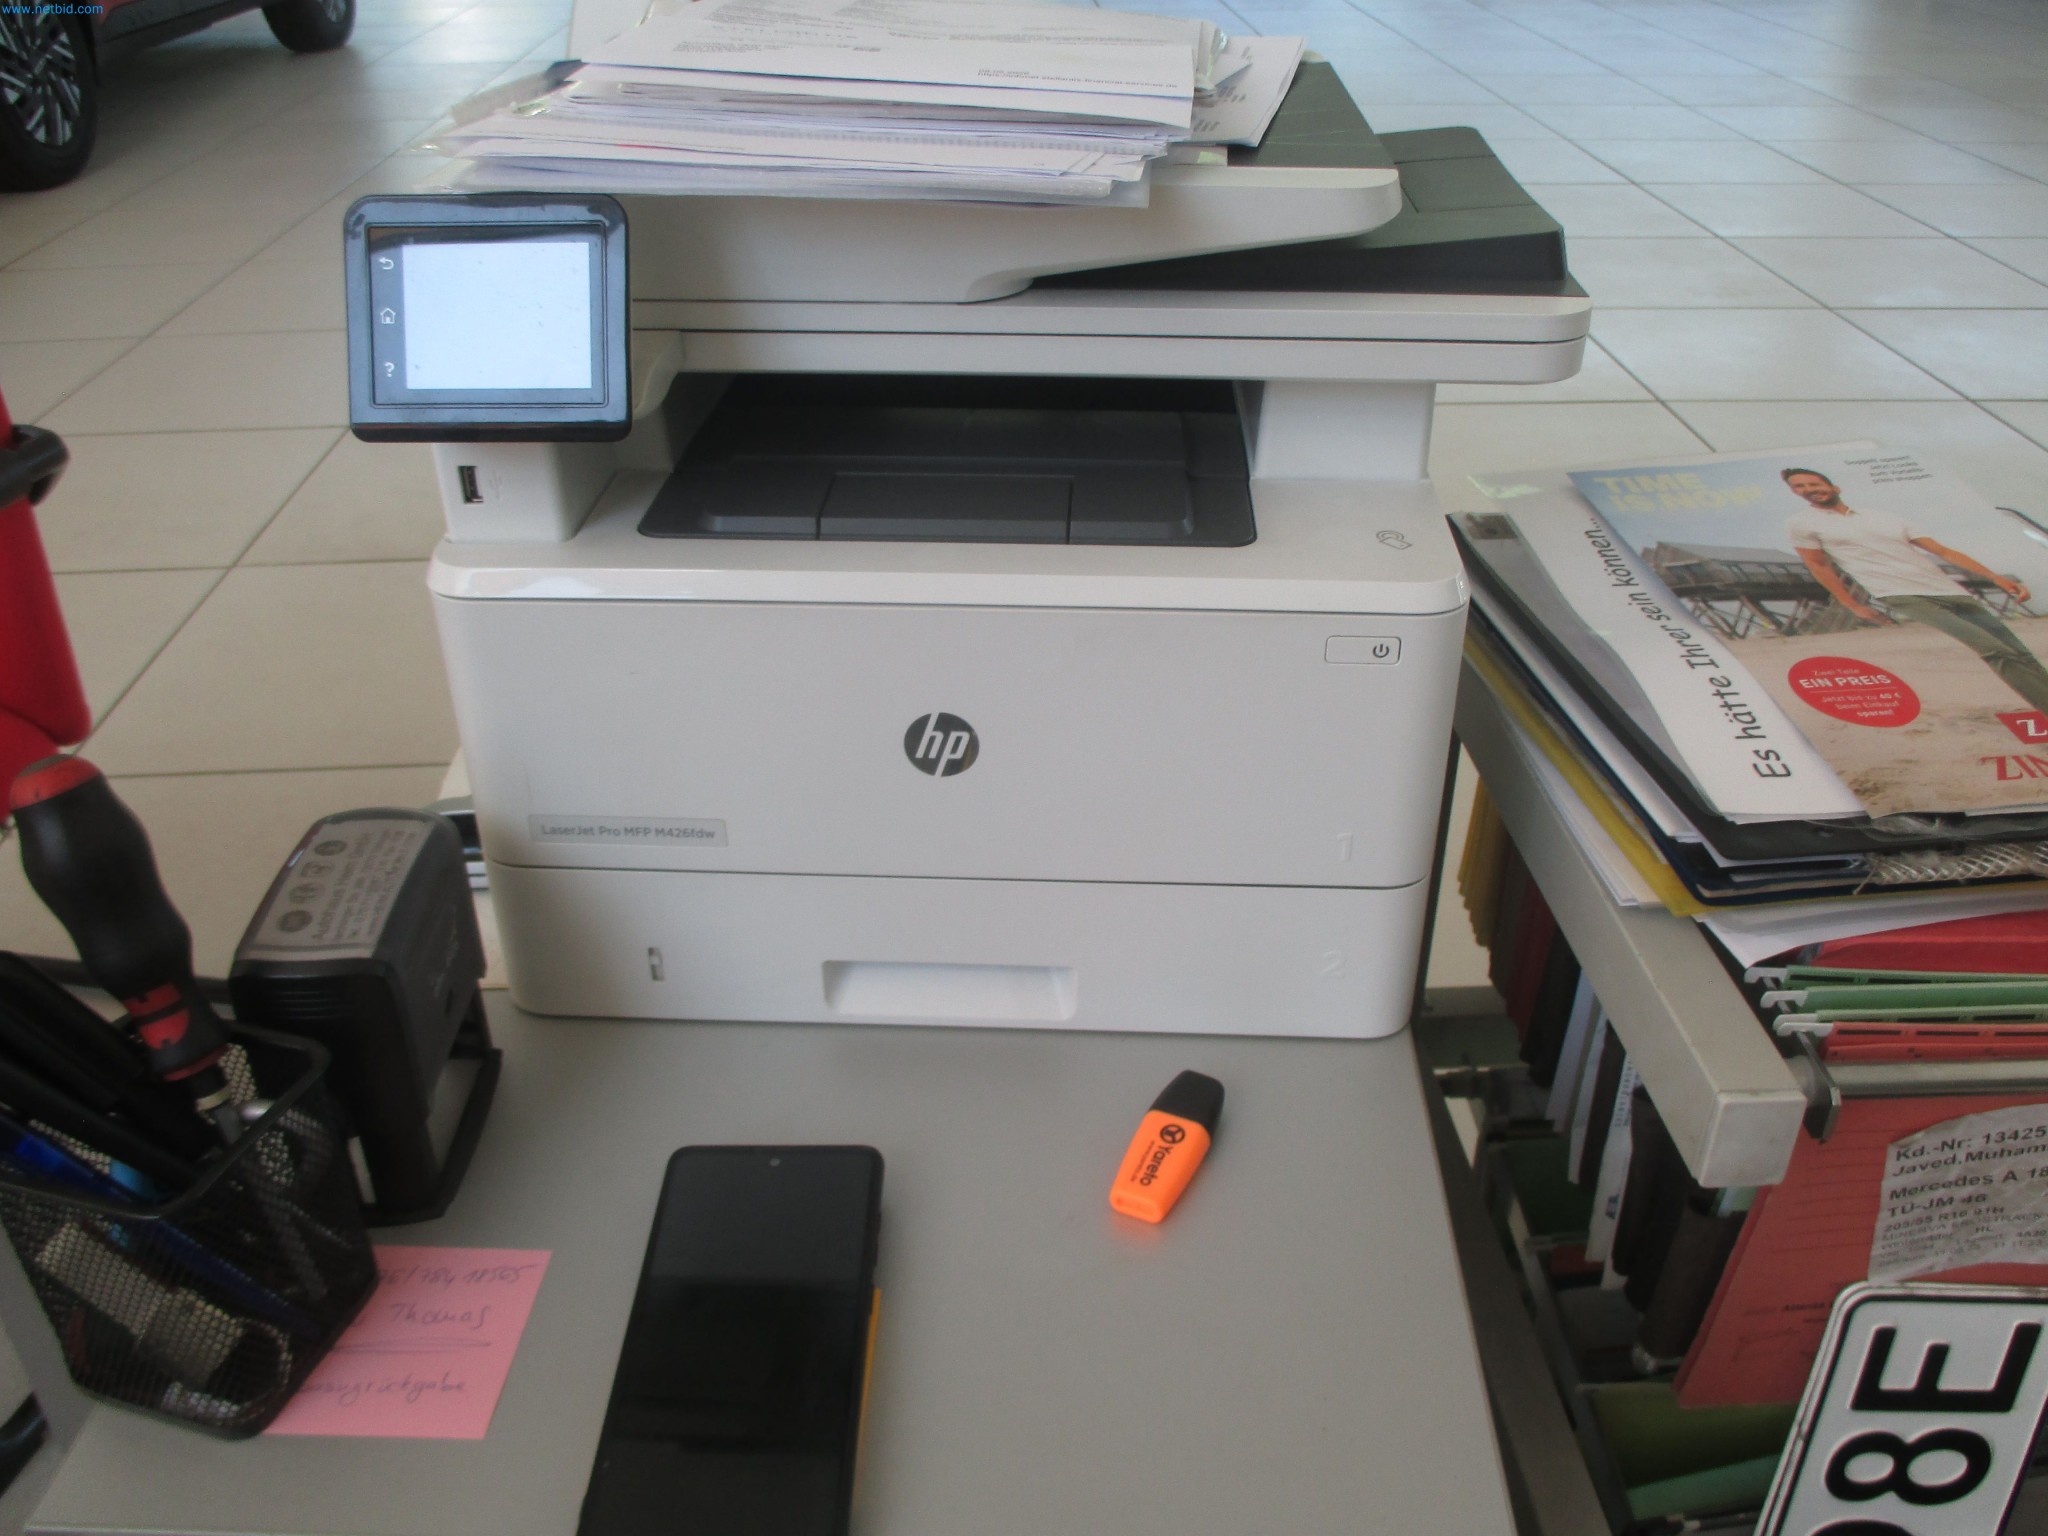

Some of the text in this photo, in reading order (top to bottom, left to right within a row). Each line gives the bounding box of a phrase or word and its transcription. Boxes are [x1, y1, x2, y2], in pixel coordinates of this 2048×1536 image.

[1593, 473, 1701, 495] TIME
[1609, 494, 1655, 512] IS
[1583, 517, 1791, 779] Es hätte Ihrer sein können...
[1799, 674, 1892, 689] EIN PREIS
[2016, 719, 2048, 737] Z
[909, 712, 976, 777] hp
[541, 825, 716, 839] LaserJet Pro MFP M426fdw
[1336, 833, 1354, 862] 1
[1982, 1125, 2047, 1145] 13425
[1139, 1144, 1173, 1187] Yareto
[1889, 1173, 1994, 1201] Mercedes
[2002, 1169, 2018, 1183] A
[391, 1302, 492, 1330] Thomas
[1807, 1321, 2043, 1536] 8E
